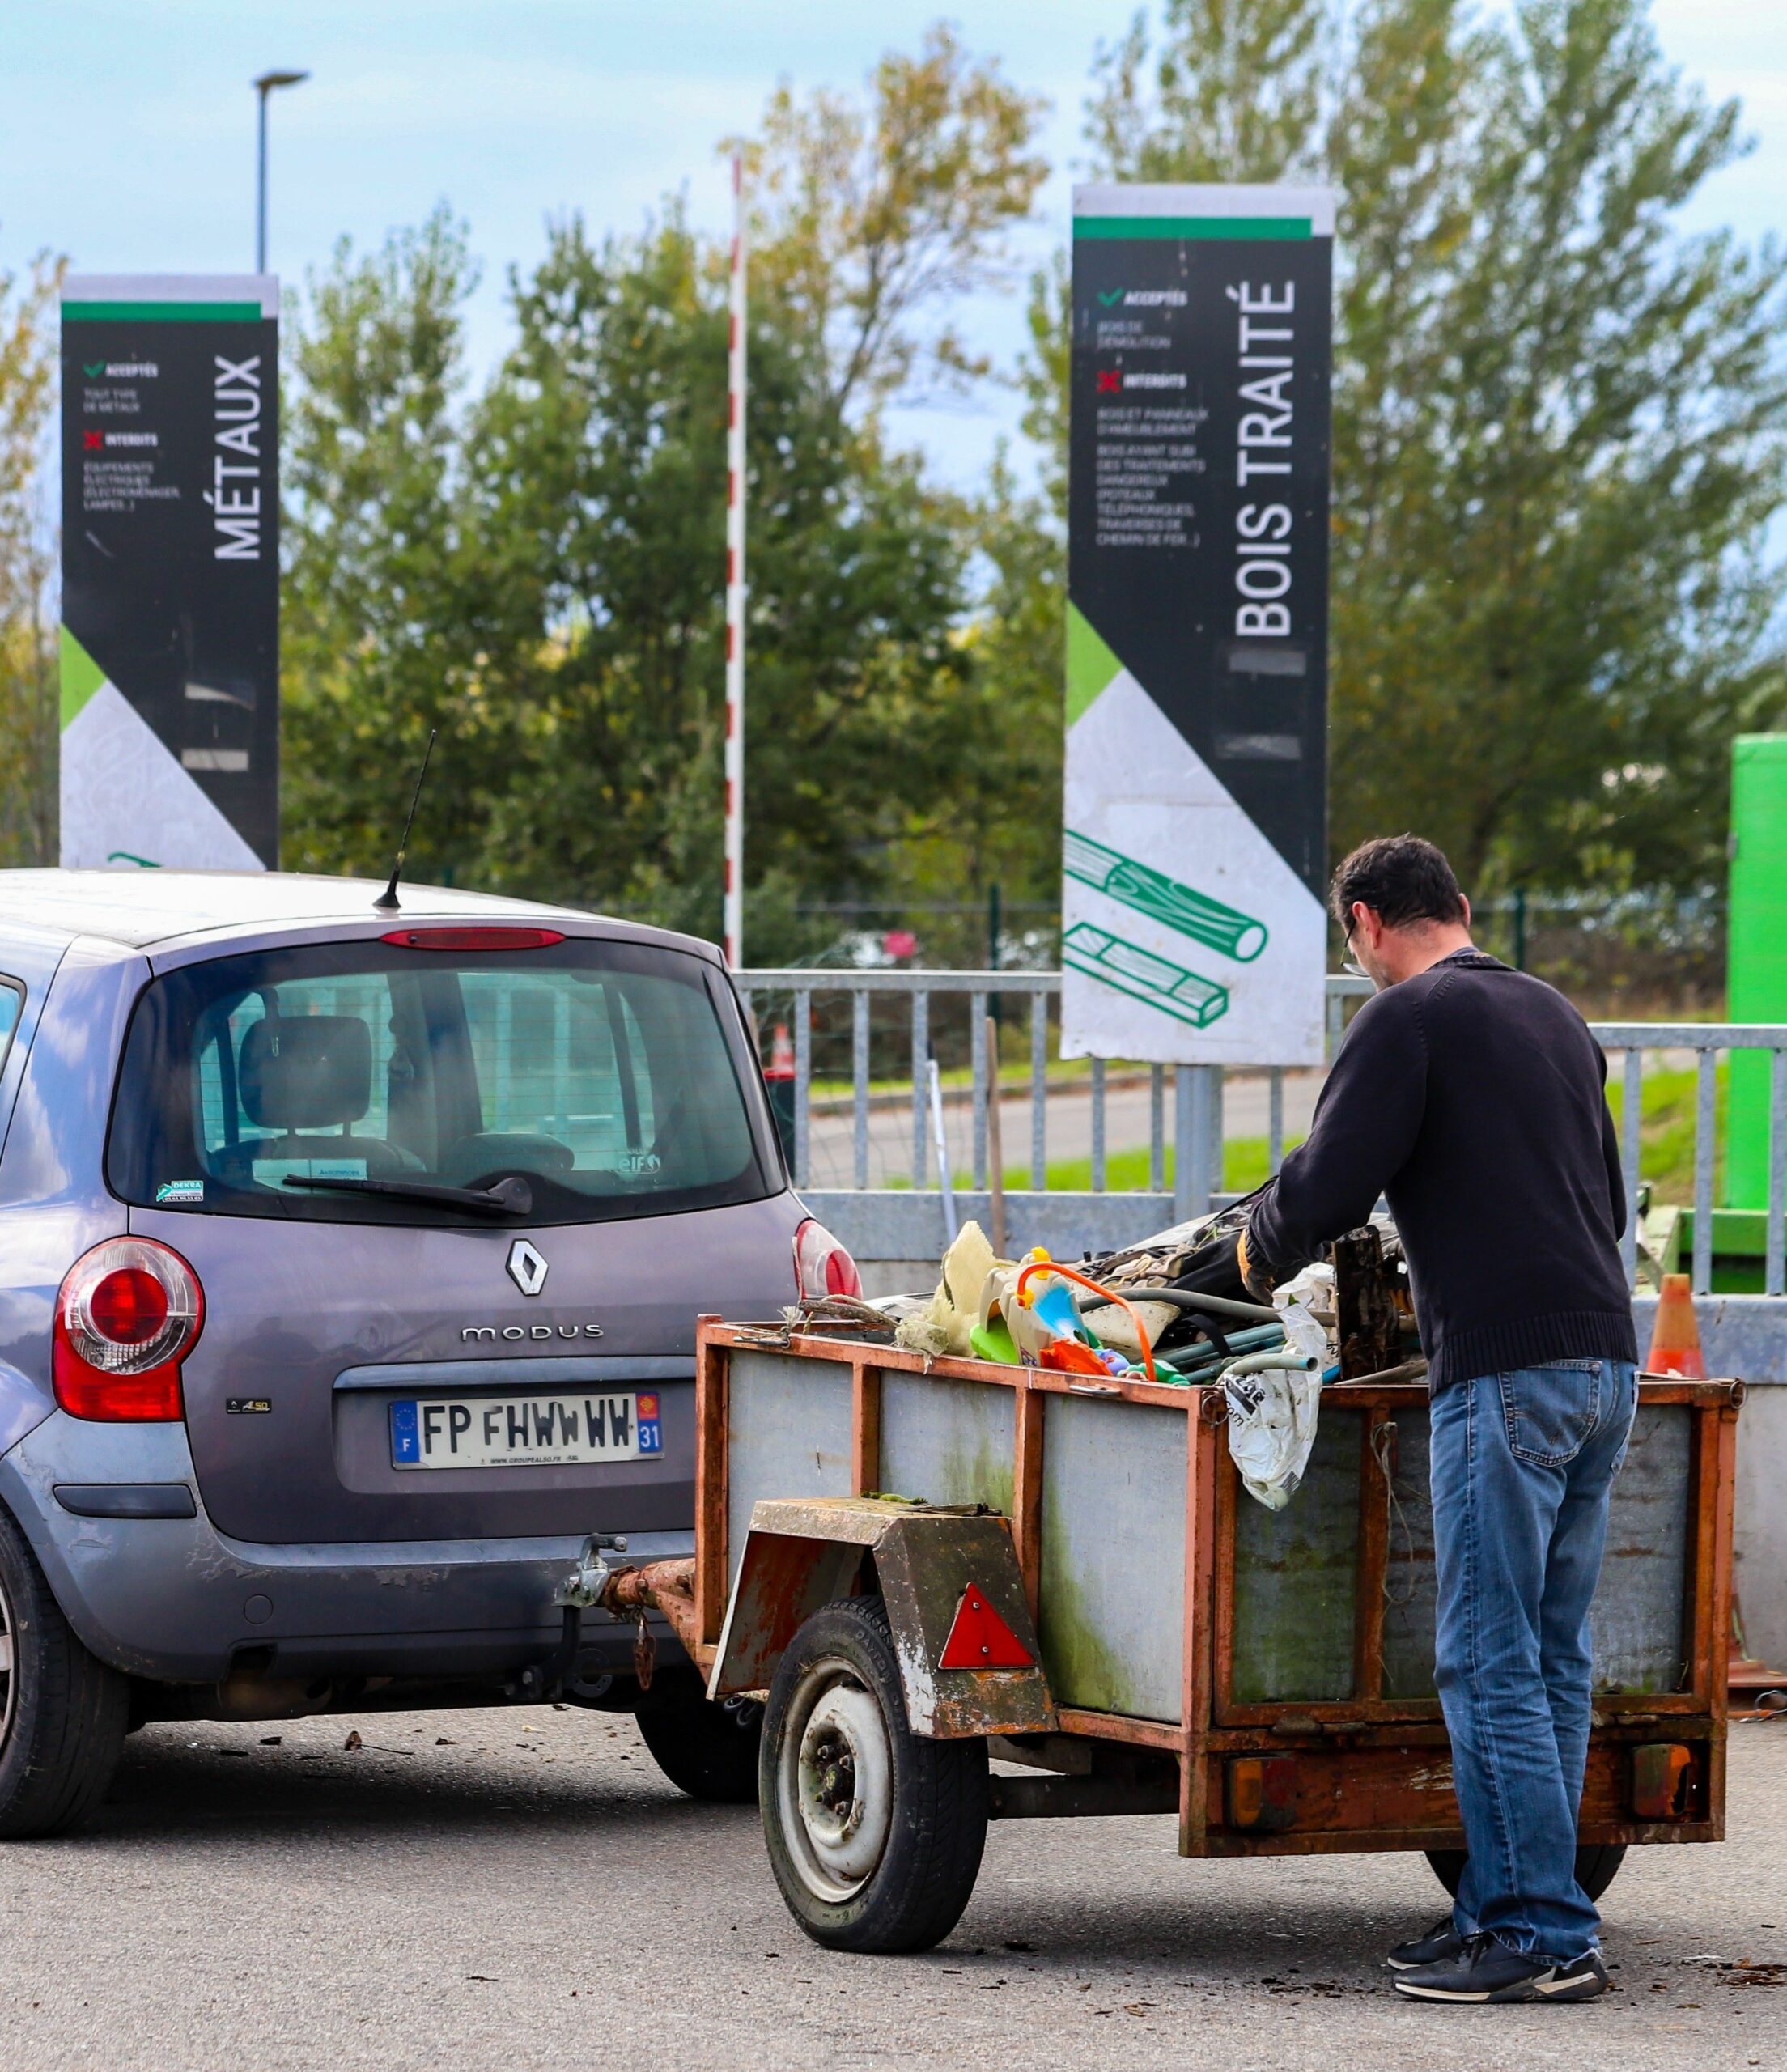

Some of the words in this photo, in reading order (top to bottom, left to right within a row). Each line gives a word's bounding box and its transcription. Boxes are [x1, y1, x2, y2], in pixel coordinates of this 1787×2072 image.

[203, 355, 261, 560] MÉTAUX
[1225, 280, 1296, 487] TRAITÉ
[1235, 503, 1293, 637] BOIS
[402, 1438, 411, 1452] F
[423, 1405, 472, 1454] FP
[640, 1426, 660, 1448] 31
